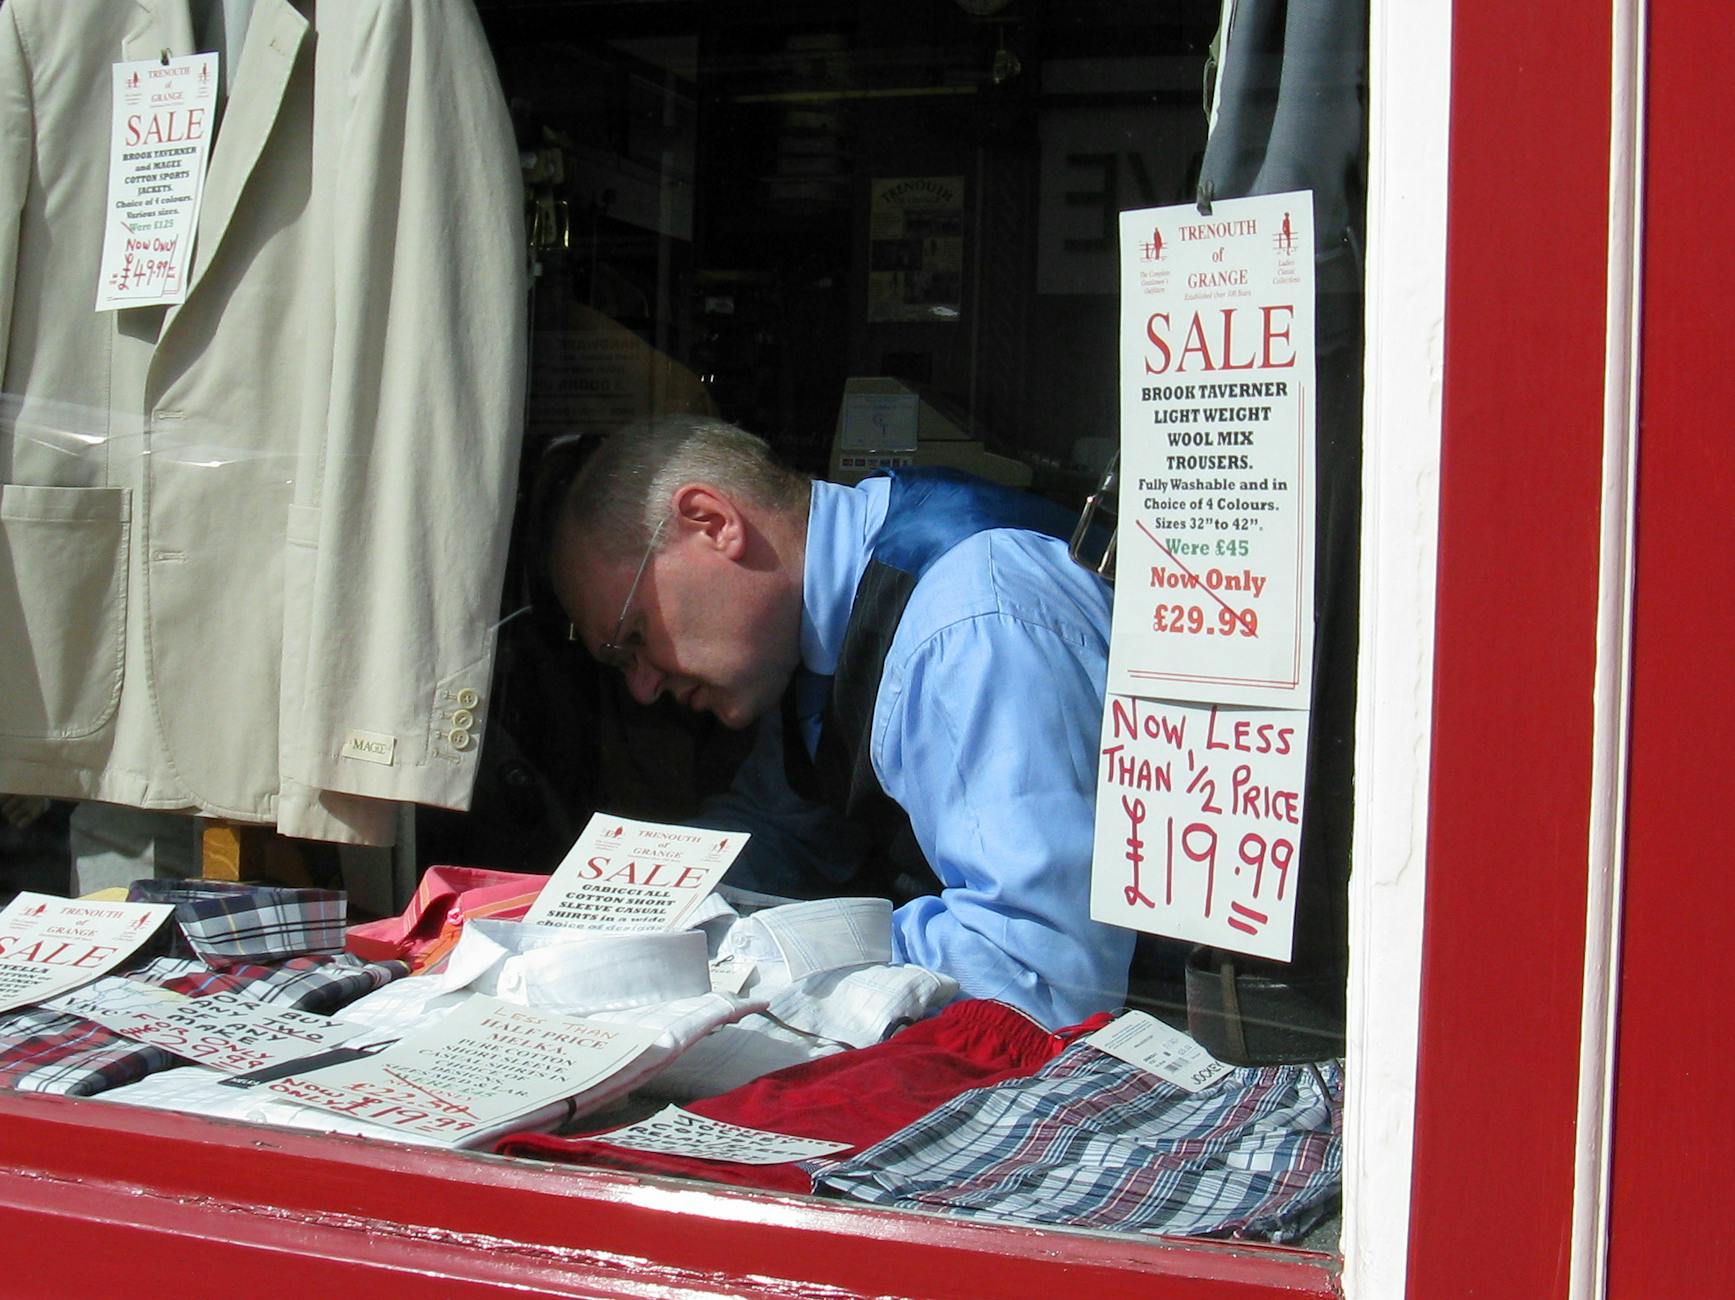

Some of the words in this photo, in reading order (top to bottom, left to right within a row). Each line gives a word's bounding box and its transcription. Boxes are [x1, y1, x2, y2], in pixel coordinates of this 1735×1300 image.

[148, 66, 191, 78] TRENOUTH
[164, 81, 173, 90] of
[151, 91, 184, 103] GRANGE
[125, 108, 205, 147] SALE
[122, 149, 152, 162] BROOK
[154, 146, 197, 160] TAVERNER
[134, 162, 152, 172] and
[153, 159, 182, 170] MAGEE
[124, 172, 158, 185] COTTON
[159, 170, 190, 181] SPORTS
[137, 183, 174, 196] JACKETS.
[116, 198, 143, 209] Choice
[144, 197, 154, 207] of
[160, 195, 194, 206] colours.
[126, 208, 157, 219] Various
[129, 220, 152, 232] Were
[153, 218, 175, 231] £125
[1178, 219, 1257, 242] TRENOUTH
[1211, 246, 1225, 263] of
[1187, 269, 1248, 289] GRANGE
[1144, 304, 1297, 375] SALE
[1141, 385, 1196, 402] BROOK
[1199, 382, 1288, 401] TAVERNER
[1154, 409, 1200, 424] LIGHT
[1203, 406, 1272, 423] WEIGHT
[1168, 432, 1214, 447] WOOL
[1217, 431, 1254, 446] MIX
[1166, 455, 1254, 471] TROUSERS.
[1138, 478, 1169, 493] Fully
[1170, 478, 1236, 491] Washable
[1239, 479, 1268, 491] and
[1272, 478, 1288, 491] in
[1144, 498, 1187, 511] Choice
[1189, 497, 1204, 511] of
[1206, 498, 1214, 511] 4
[1217, 498, 1280, 512] Colours.
[1155, 517, 1187, 530] Sizes
[1214, 518, 1229, 530] to
[1166, 538, 1210, 556] Were
[1215, 539, 1249, 557] £45
[1150, 566, 1200, 590] Now
[1206, 567, 1267, 598] Only
[1153, 603, 1259, 638] £29.99
[1112, 696, 1186, 750] NOW
[1206, 703, 1295, 755] LESS
[1102, 744, 1172, 793] THAN
[1231, 764, 1299, 824] PRICE
[638, 830, 702, 844] TRENOUTH
[632, 847, 684, 859] GRANGE
[1122, 794, 1295, 918] £19.99
[577, 856, 711, 890] SALE
[582, 883, 645, 898] GABICCI
[645, 890, 672, 898] ALL
[565, 892, 626, 904] COTTON
[627, 896, 677, 907] SHORT
[60, 907, 125, 919] TRENOUTH
[559, 901, 613, 913] SLEEVE
[615, 907, 668, 915] CASUAL
[75, 919, 91, 927] of
[536, 919, 586, 930] choice
[588, 922, 609, 931] of
[547, 910, 599, 921] SHIRTS
[630, 915, 666, 924] wide
[47, 926, 99, 937] GRANGE
[190, 998, 249, 1018] ANY
[263, 1017, 324, 1041] TWO
[212, 994, 262, 1011] OR
[279, 1012, 343, 1029] BUY
[167, 1014, 256, 1046] MAKE
[178, 1006, 218, 1021] OF
[230, 1022, 289, 1043] ANY
[494, 1007, 547, 1025] LESS
[562, 1022, 620, 1040] THAN
[132, 1013, 190, 1036] FOR
[201, 1036, 275, 1060] ONLY
[480, 1018, 541, 1037] HALF
[541, 1030, 609, 1050] PRICE
[442, 1045, 502, 1060] SHORT
[504, 1056, 569, 1074] SLEEVE
[458, 1038, 503, 1052] PURE
[505, 1048, 576, 1067] COTTON
[419, 1049, 481, 1066] CASUAL
[482, 1060, 547, 1078] SHIRTS
[435, 1059, 500, 1075] CHOICE
[281, 1077, 345, 1098] NOW
